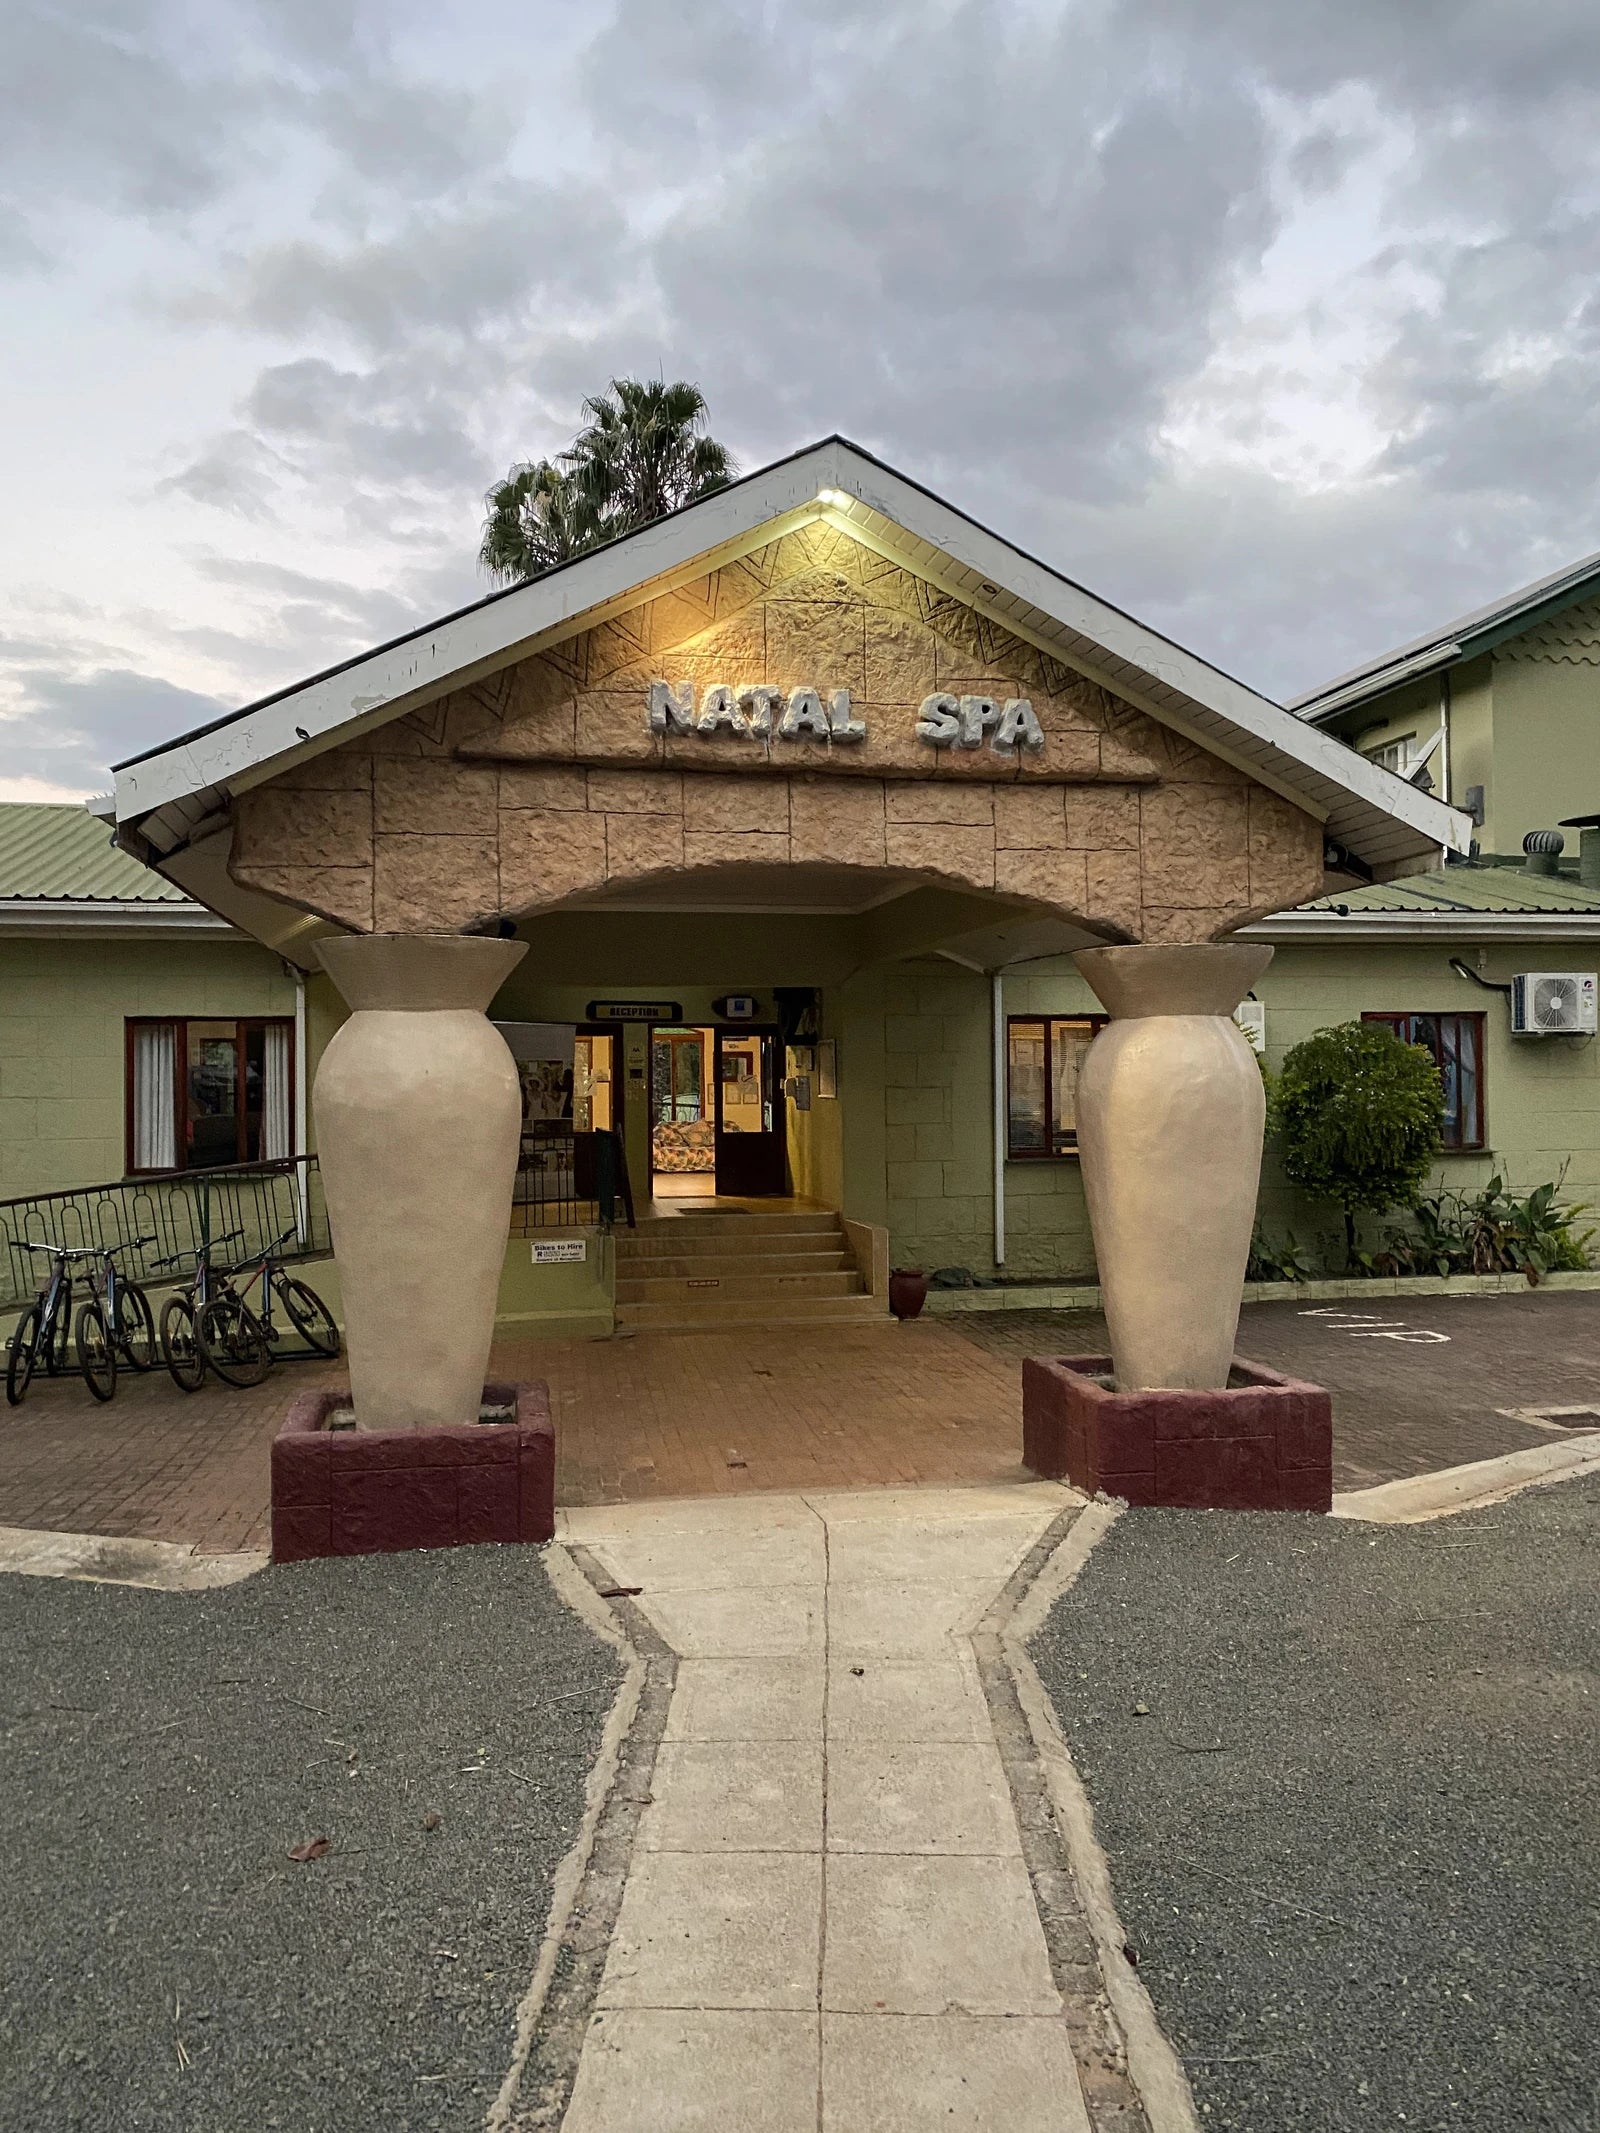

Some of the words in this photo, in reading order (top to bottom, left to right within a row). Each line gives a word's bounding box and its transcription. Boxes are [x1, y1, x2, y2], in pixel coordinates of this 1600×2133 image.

[649, 680, 866, 742] NATAL
[915, 691, 1046, 748] SPA
[609, 1007, 659, 1017] RECEPTION
